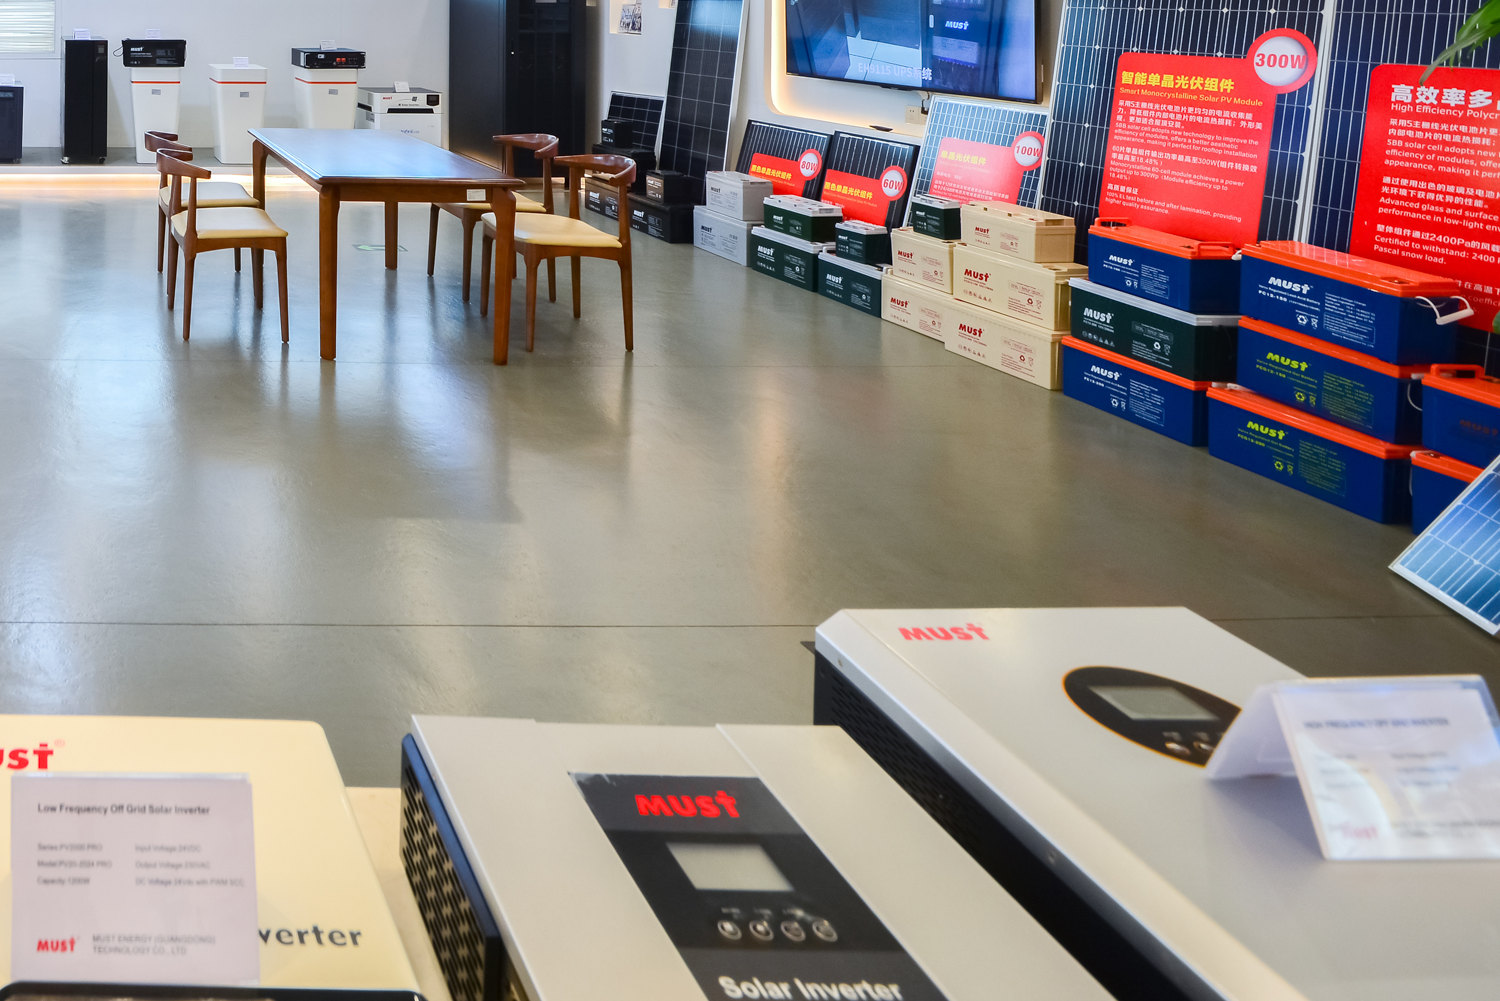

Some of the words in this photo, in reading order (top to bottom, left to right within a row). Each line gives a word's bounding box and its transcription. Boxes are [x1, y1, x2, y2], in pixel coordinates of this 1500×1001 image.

[945, 20, 969, 30] MUST
[1255, 53, 1307, 70] 300W
[858, 63, 891, 76] EH9115
[894, 64, 932, 81] UPS系统
[1122, 71, 1234, 93] 智能单晶光伏组件
[1141, 89, 1197, 100] Monocrystalline
[1199, 95, 1219, 103] Solar
[1233, 98, 1263, 106] Module
[1391, 84, 1500, 110] 高效率多
[1391, 103, 1413, 113] High
[1416, 105, 1463, 117] Efficiency
[1016, 146, 1042, 157] 100W
[1405, 141, 1425, 149] solar
[1444, 146, 1474, 155] adopts
[801, 161, 818, 172] 80W
[883, 179, 903, 191] 60W
[1379, 197, 1419, 209] Advanced
[1422, 203, 1443, 212] glass
[1446, 207, 1462, 215] and
[1465, 210, 1499, 221] surface
[1379, 207, 1431, 221] performance
[1444, 217, 1483, 229] low-light
[701, 225, 712, 234] MUST
[975, 226, 990, 234] MUST
[757, 246, 774, 256] MUST
[898, 250, 913, 259] MUST
[1374, 244, 1399, 255] Pascal
[1401, 251, 1422, 260] snow
[1425, 254, 1446, 264] load.
[1375, 235, 1409, 247] Certified
[1423, 244, 1469, 258] withstand:
[1472, 253, 1495, 263] 2400
[1109, 255, 1133, 266] MUST
[826, 273, 843, 284] MUST
[964, 268, 990, 282] MUST
[1268, 277, 1310, 294] MUST
[890, 297, 908, 308] MUST
[1083, 307, 1112, 324] MUST
[958, 323, 984, 338] MUST
[1266, 352, 1308, 372] MUST
[1091, 365, 1120, 380] MUST
[1247, 421, 1286, 440] MUST
[898, 623, 990, 641] MUST
[37, 804, 56, 813] Low
[59, 804, 108, 815] Frequency
[110, 804, 124, 814] Off
[126, 804, 146, 814] Grid
[149, 805, 172, 814] Solar
[174, 805, 210, 815] Inverter
[635, 790, 740, 818] MUST
[37, 937, 76, 952] MUST
[718, 975, 793, 1000] Solar
[794, 978, 904, 1001] Inverter
